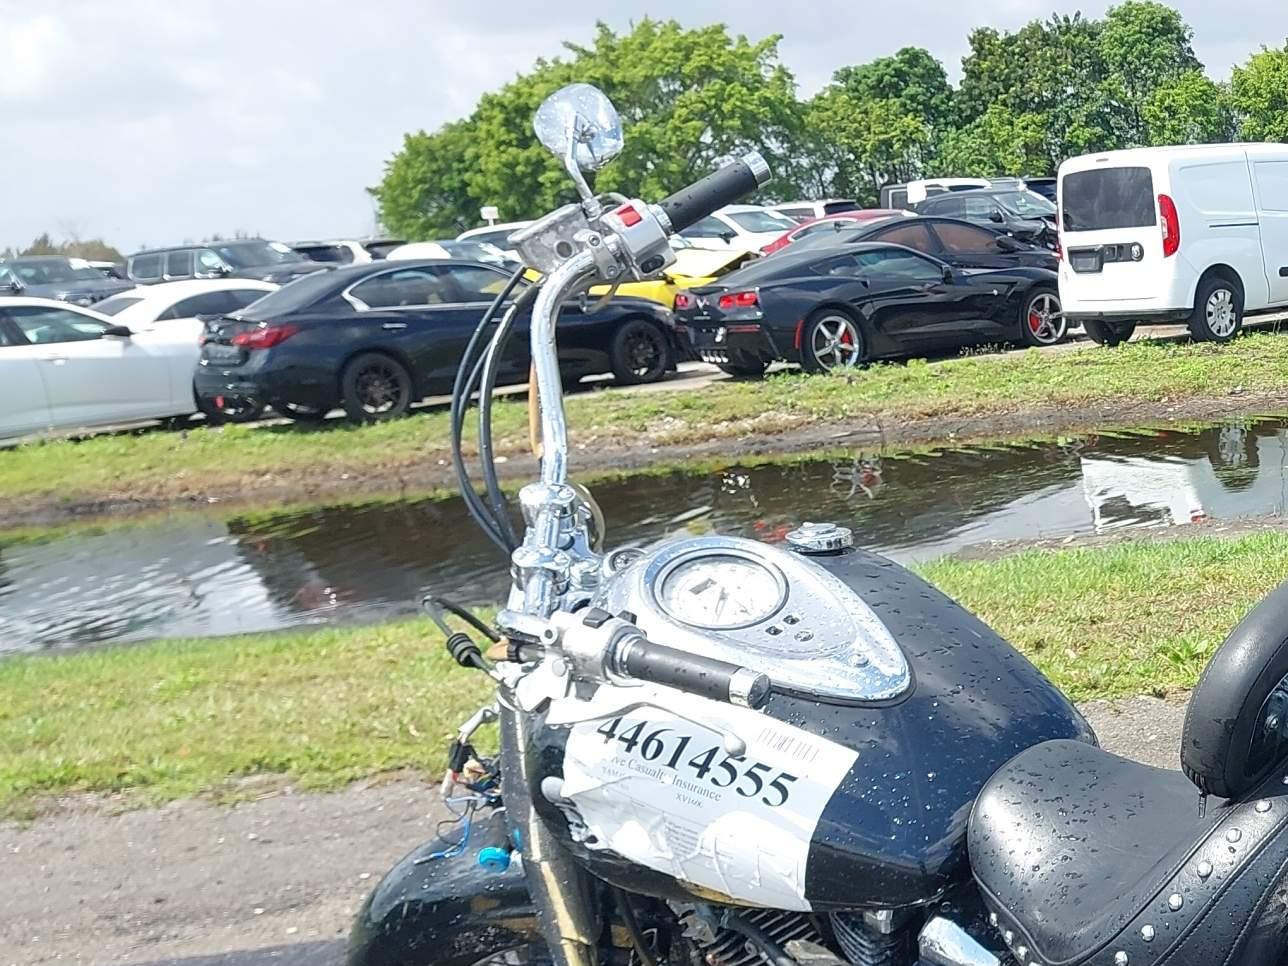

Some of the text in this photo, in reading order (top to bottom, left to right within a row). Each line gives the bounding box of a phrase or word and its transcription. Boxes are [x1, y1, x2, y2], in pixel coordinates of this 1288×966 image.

[596, 716, 800, 807] 44614555
[628, 758, 670, 784] Casualt
[672, 774, 722, 802] Insurance
